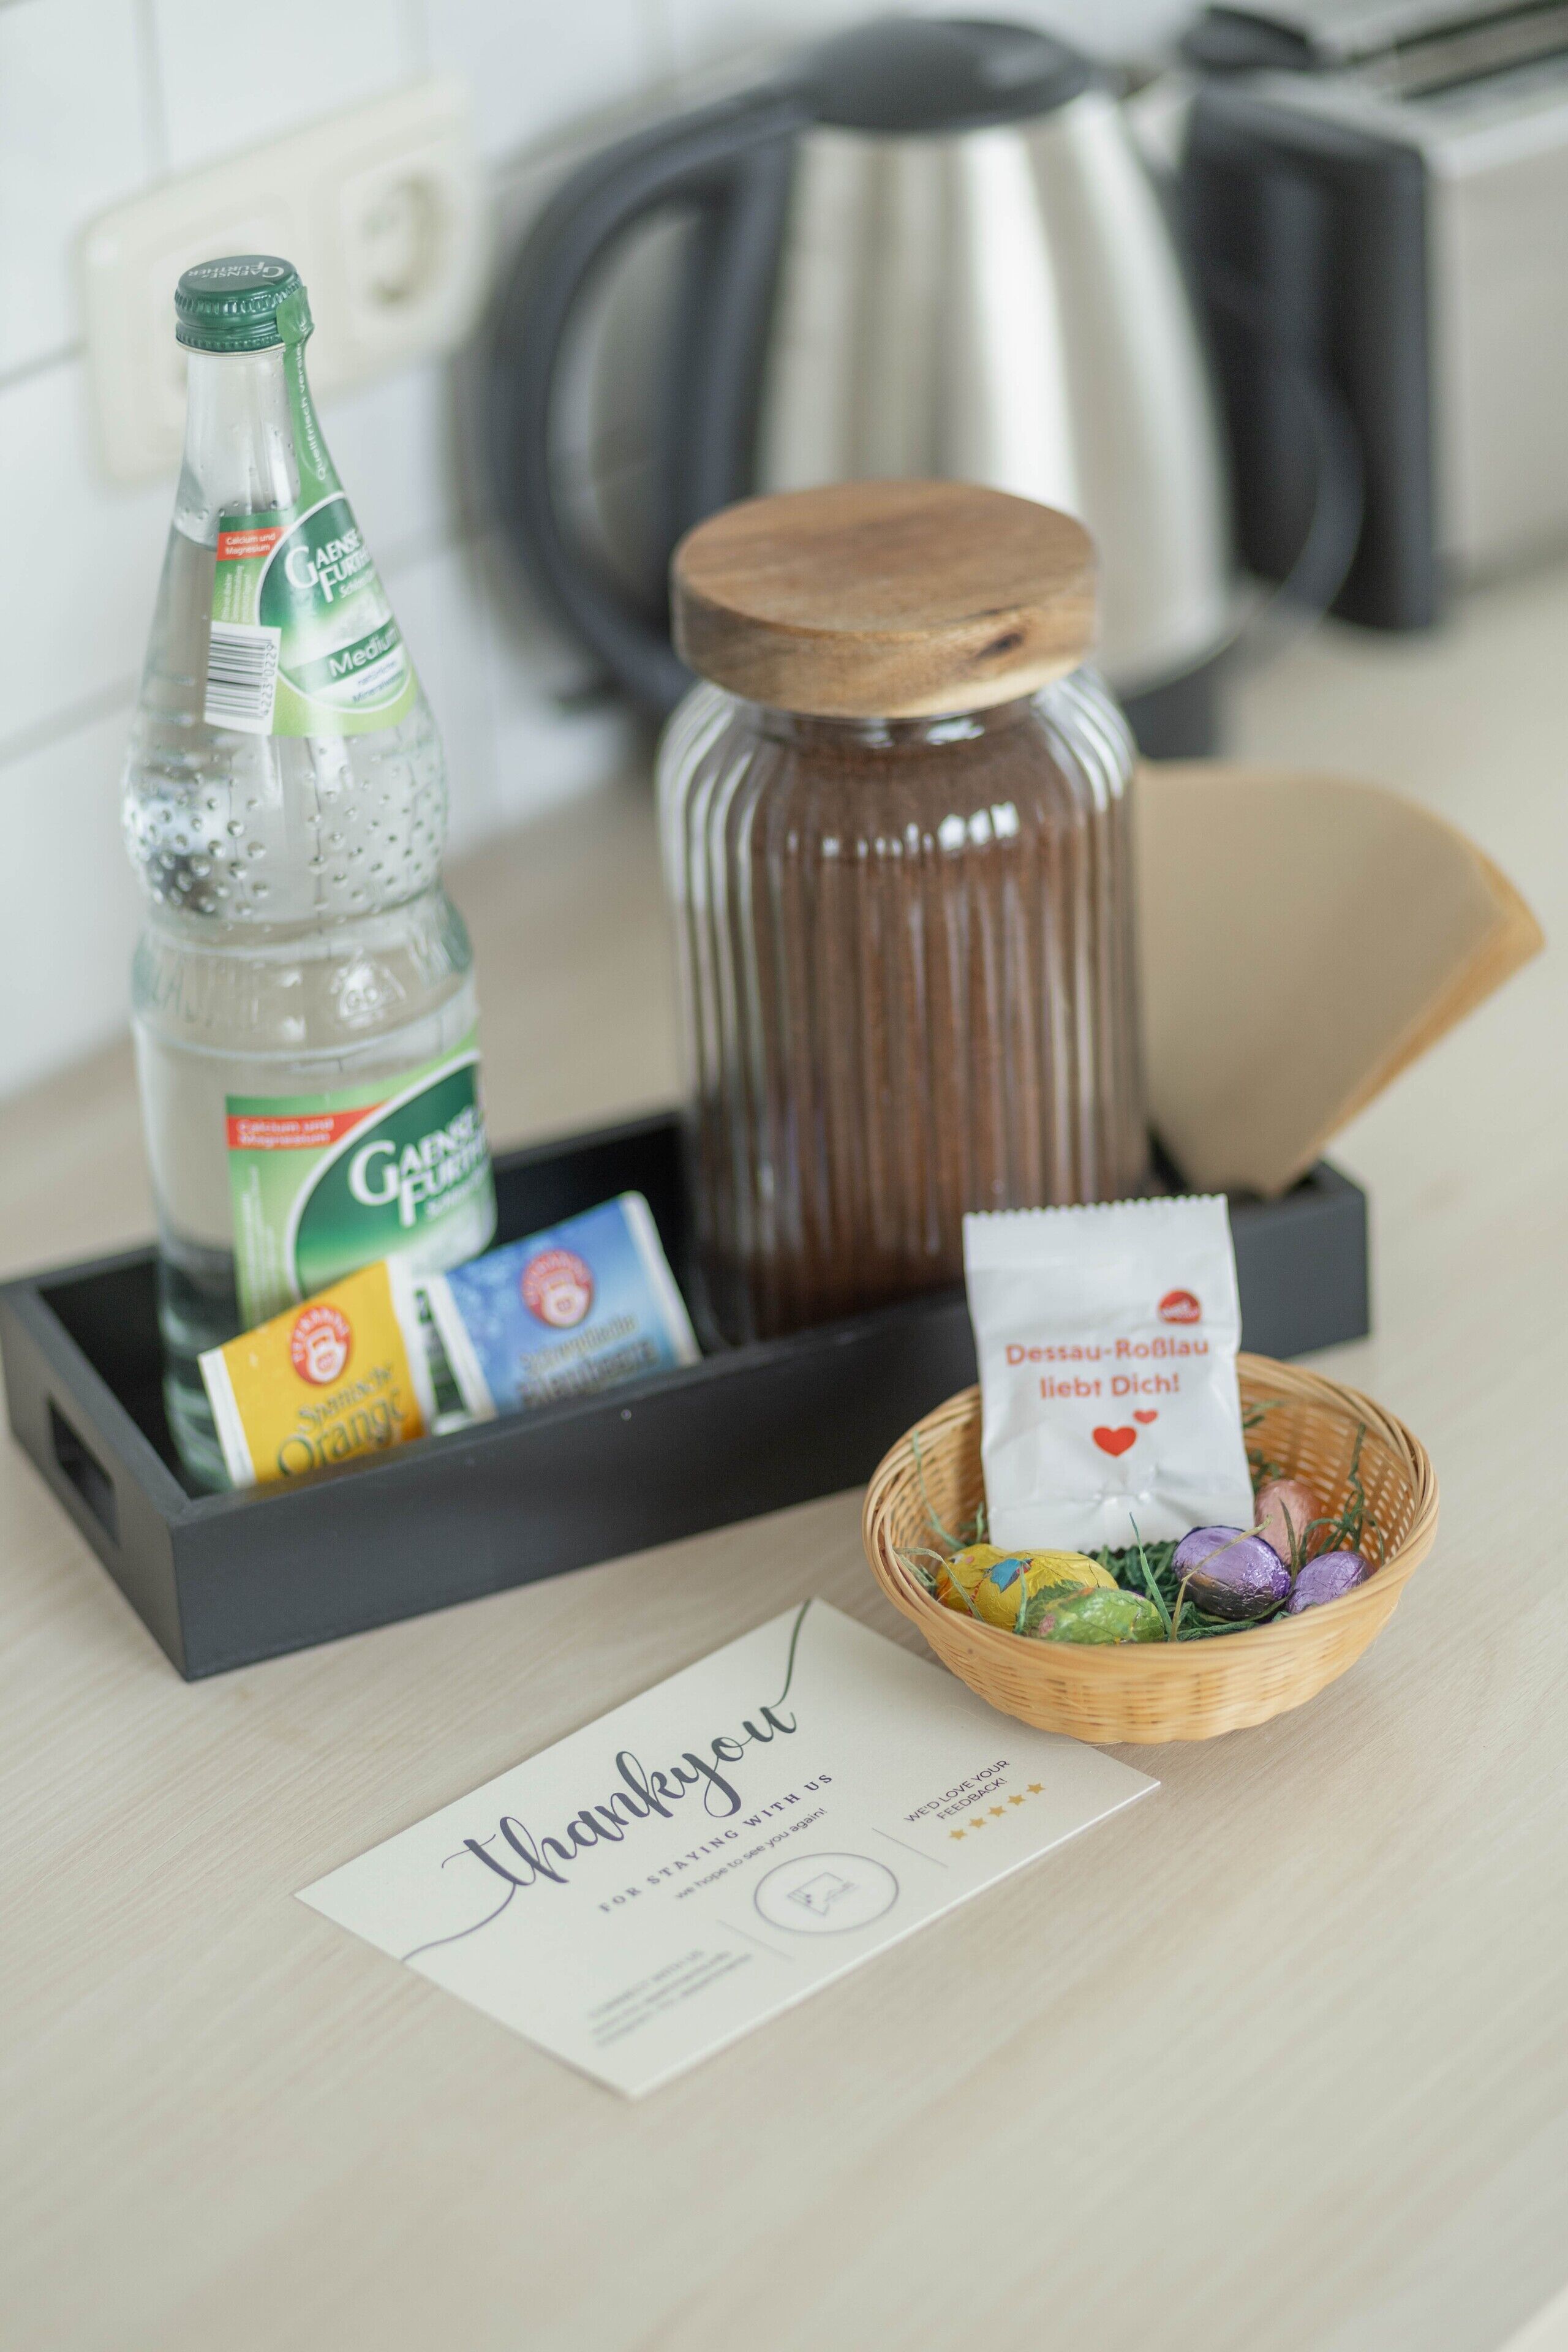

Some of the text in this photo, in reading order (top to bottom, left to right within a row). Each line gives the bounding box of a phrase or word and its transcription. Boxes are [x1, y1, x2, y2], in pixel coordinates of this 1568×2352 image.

[1005, 1337, 1208, 1366] Dessau-Roßlau
[1041, 1373, 1180, 1400] liebt Dich!
[903, 1760, 1010, 1822] WE'D LOVE YOUR
[937, 1777, 1008, 1820] FEEDBACK!
[600, 1774, 832, 1913] FOR STAYING WITH US
[675, 1807, 827, 1899] we hope to see you again!
